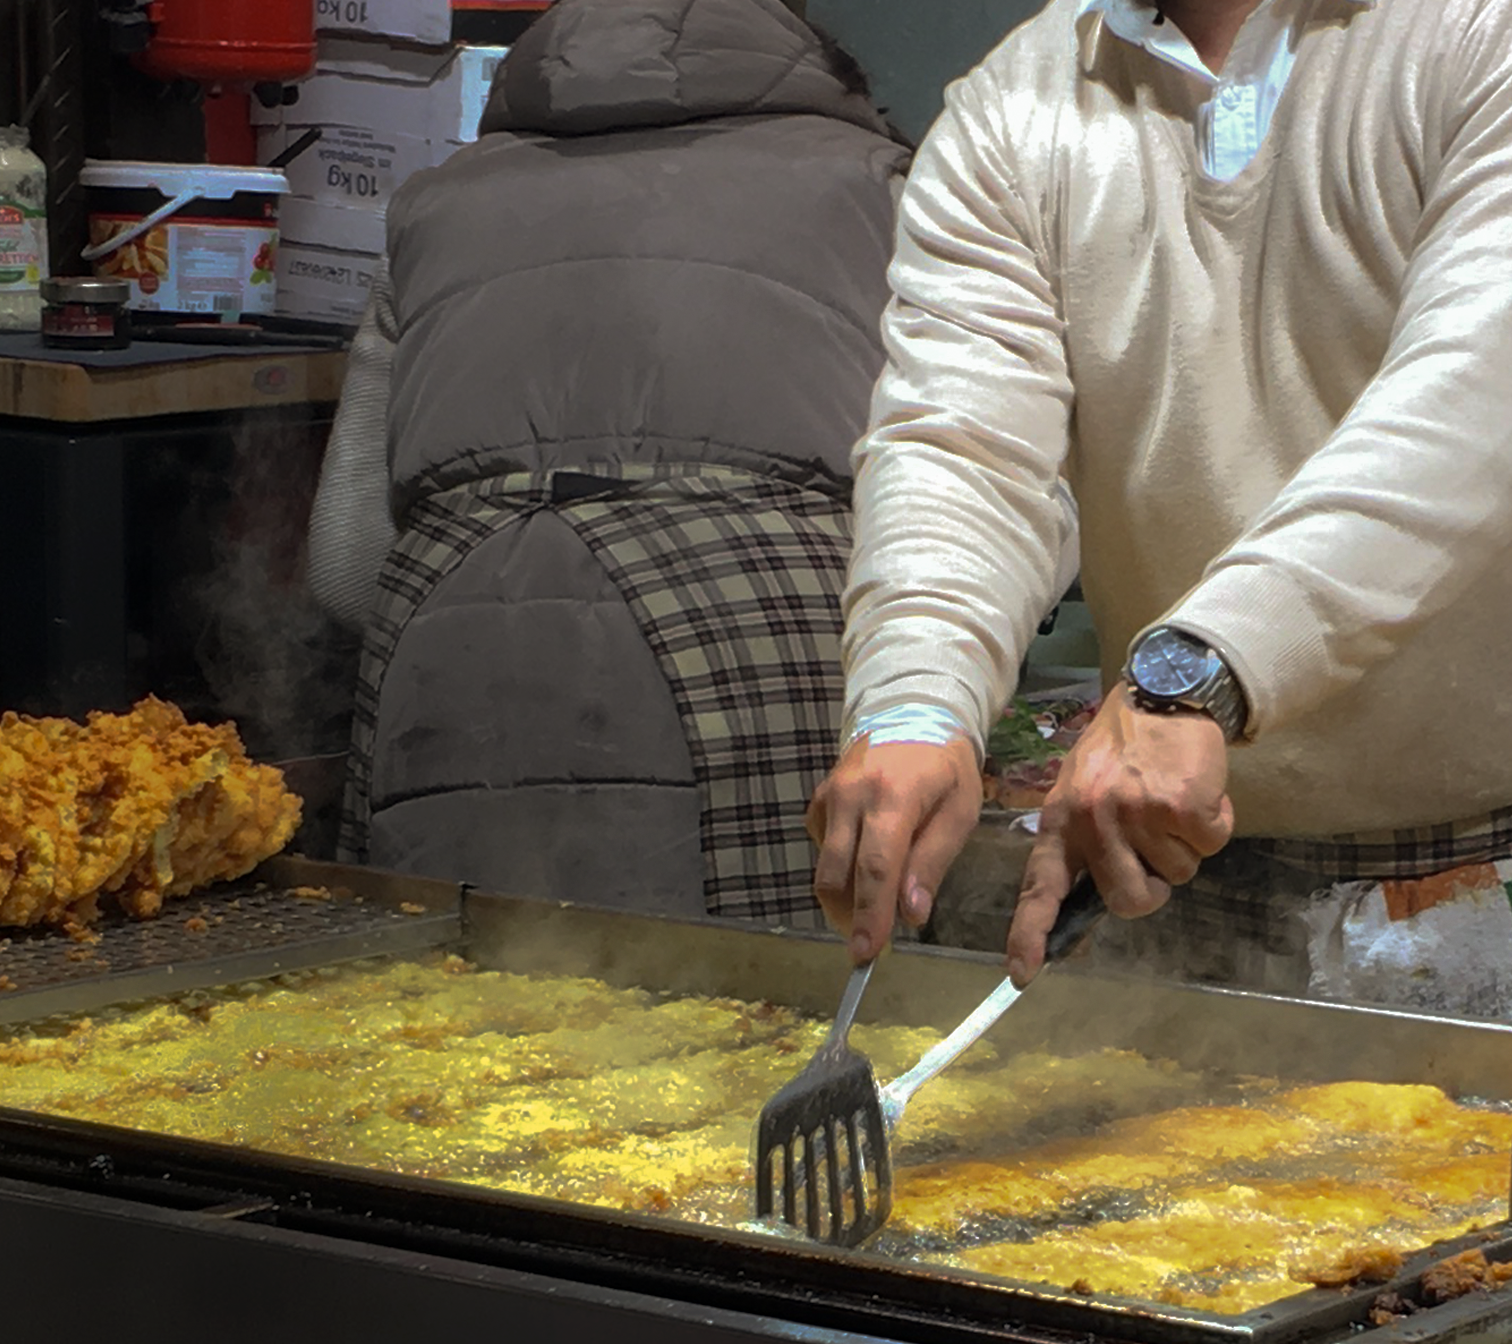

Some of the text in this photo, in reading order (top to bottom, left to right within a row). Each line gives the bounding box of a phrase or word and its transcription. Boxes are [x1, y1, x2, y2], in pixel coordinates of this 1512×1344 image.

[346, 2, 368, 23] 10
[326, 164, 379, 198] 10 kg
